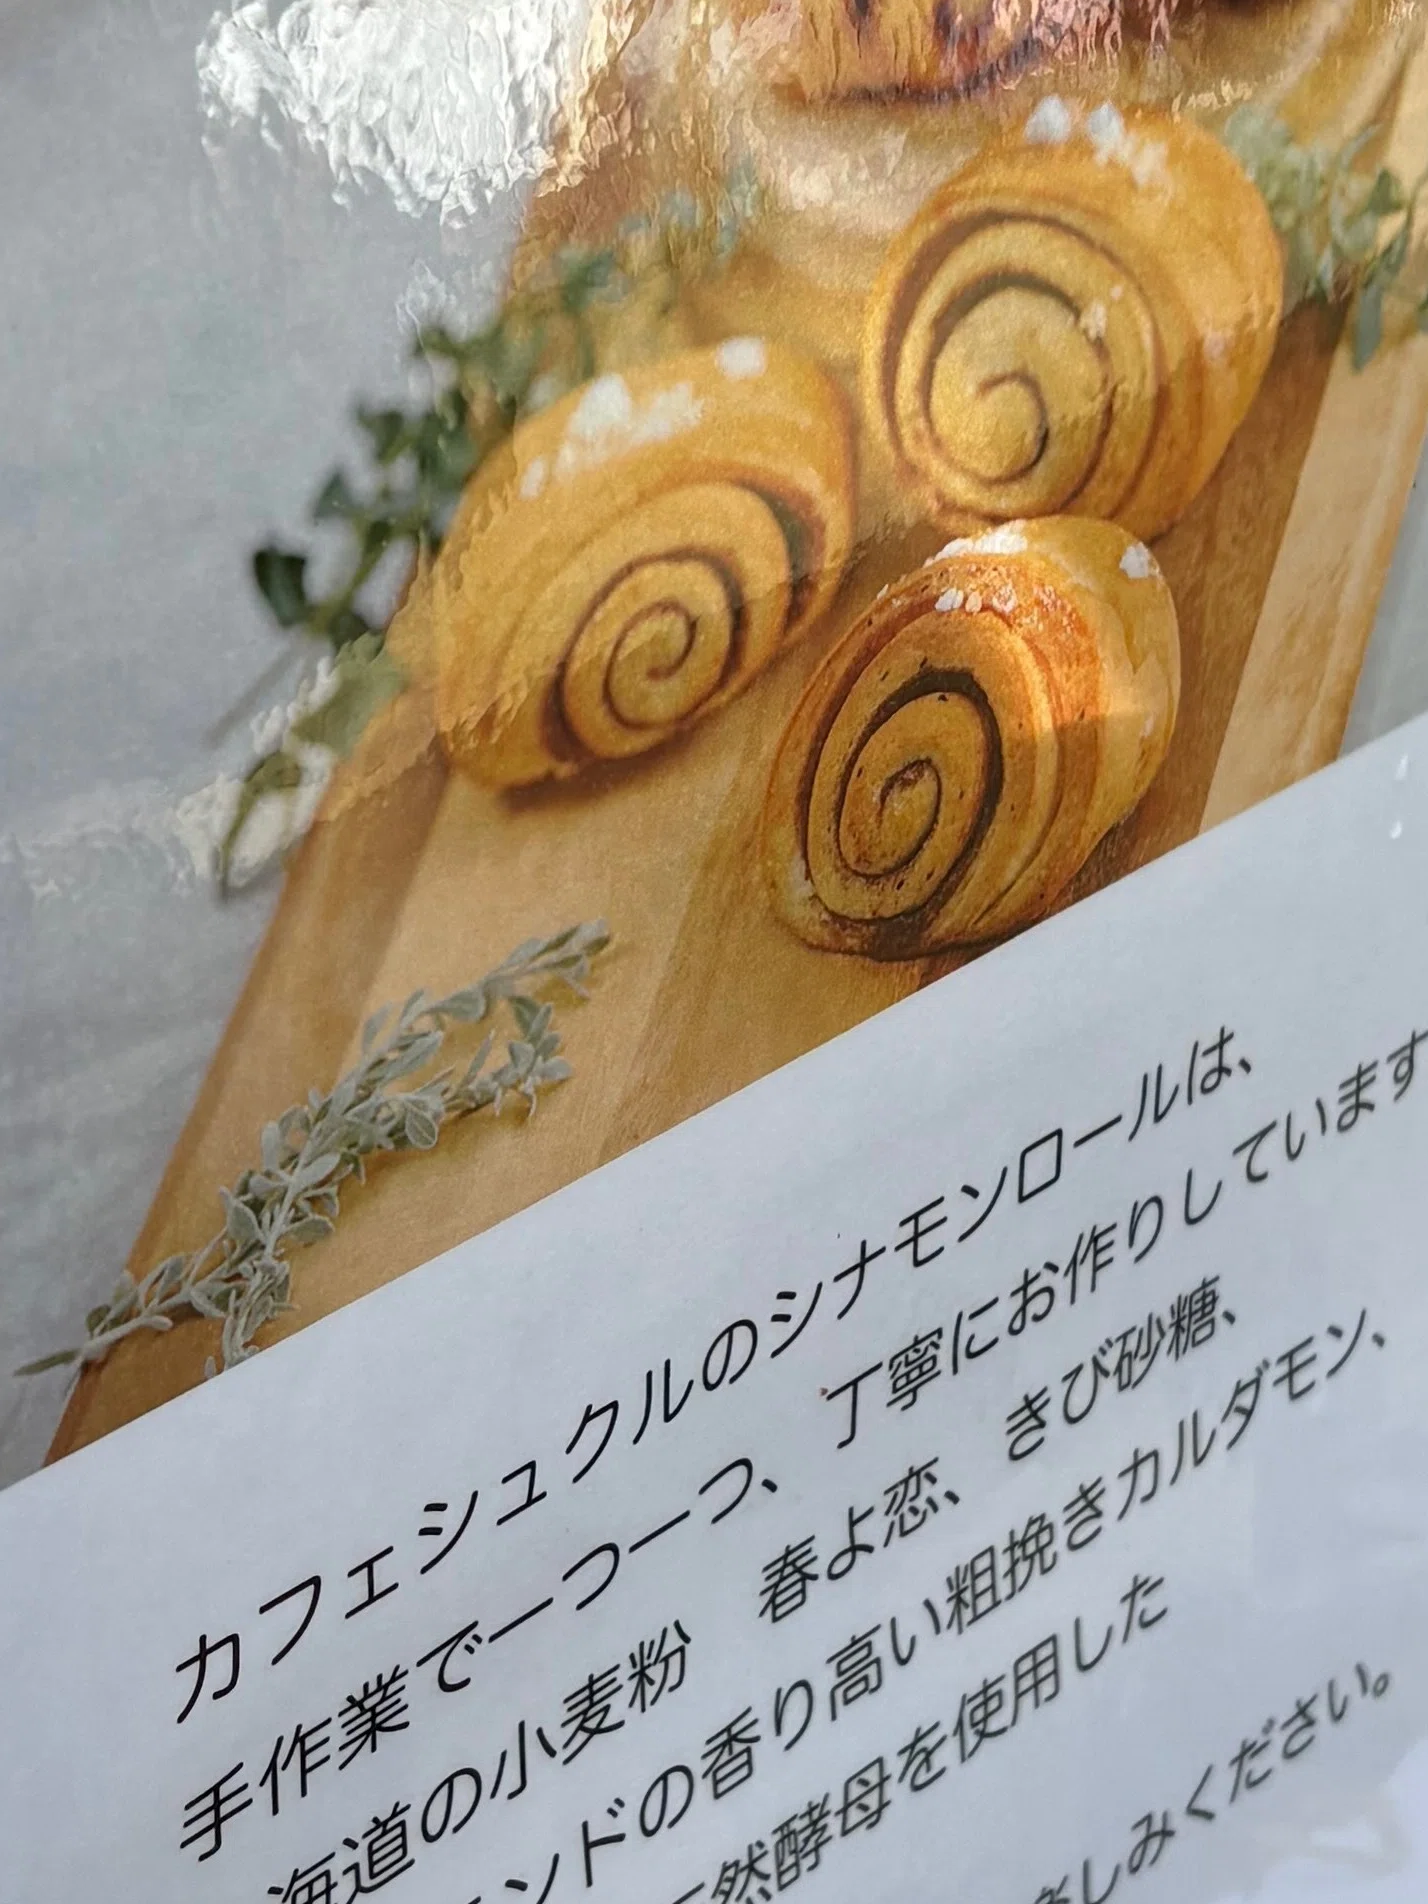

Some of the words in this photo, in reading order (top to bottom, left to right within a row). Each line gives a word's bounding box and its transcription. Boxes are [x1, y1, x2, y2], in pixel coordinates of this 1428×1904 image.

[175, 1026, 1252, 1724] カフェシュクルのシナモンロールは、
